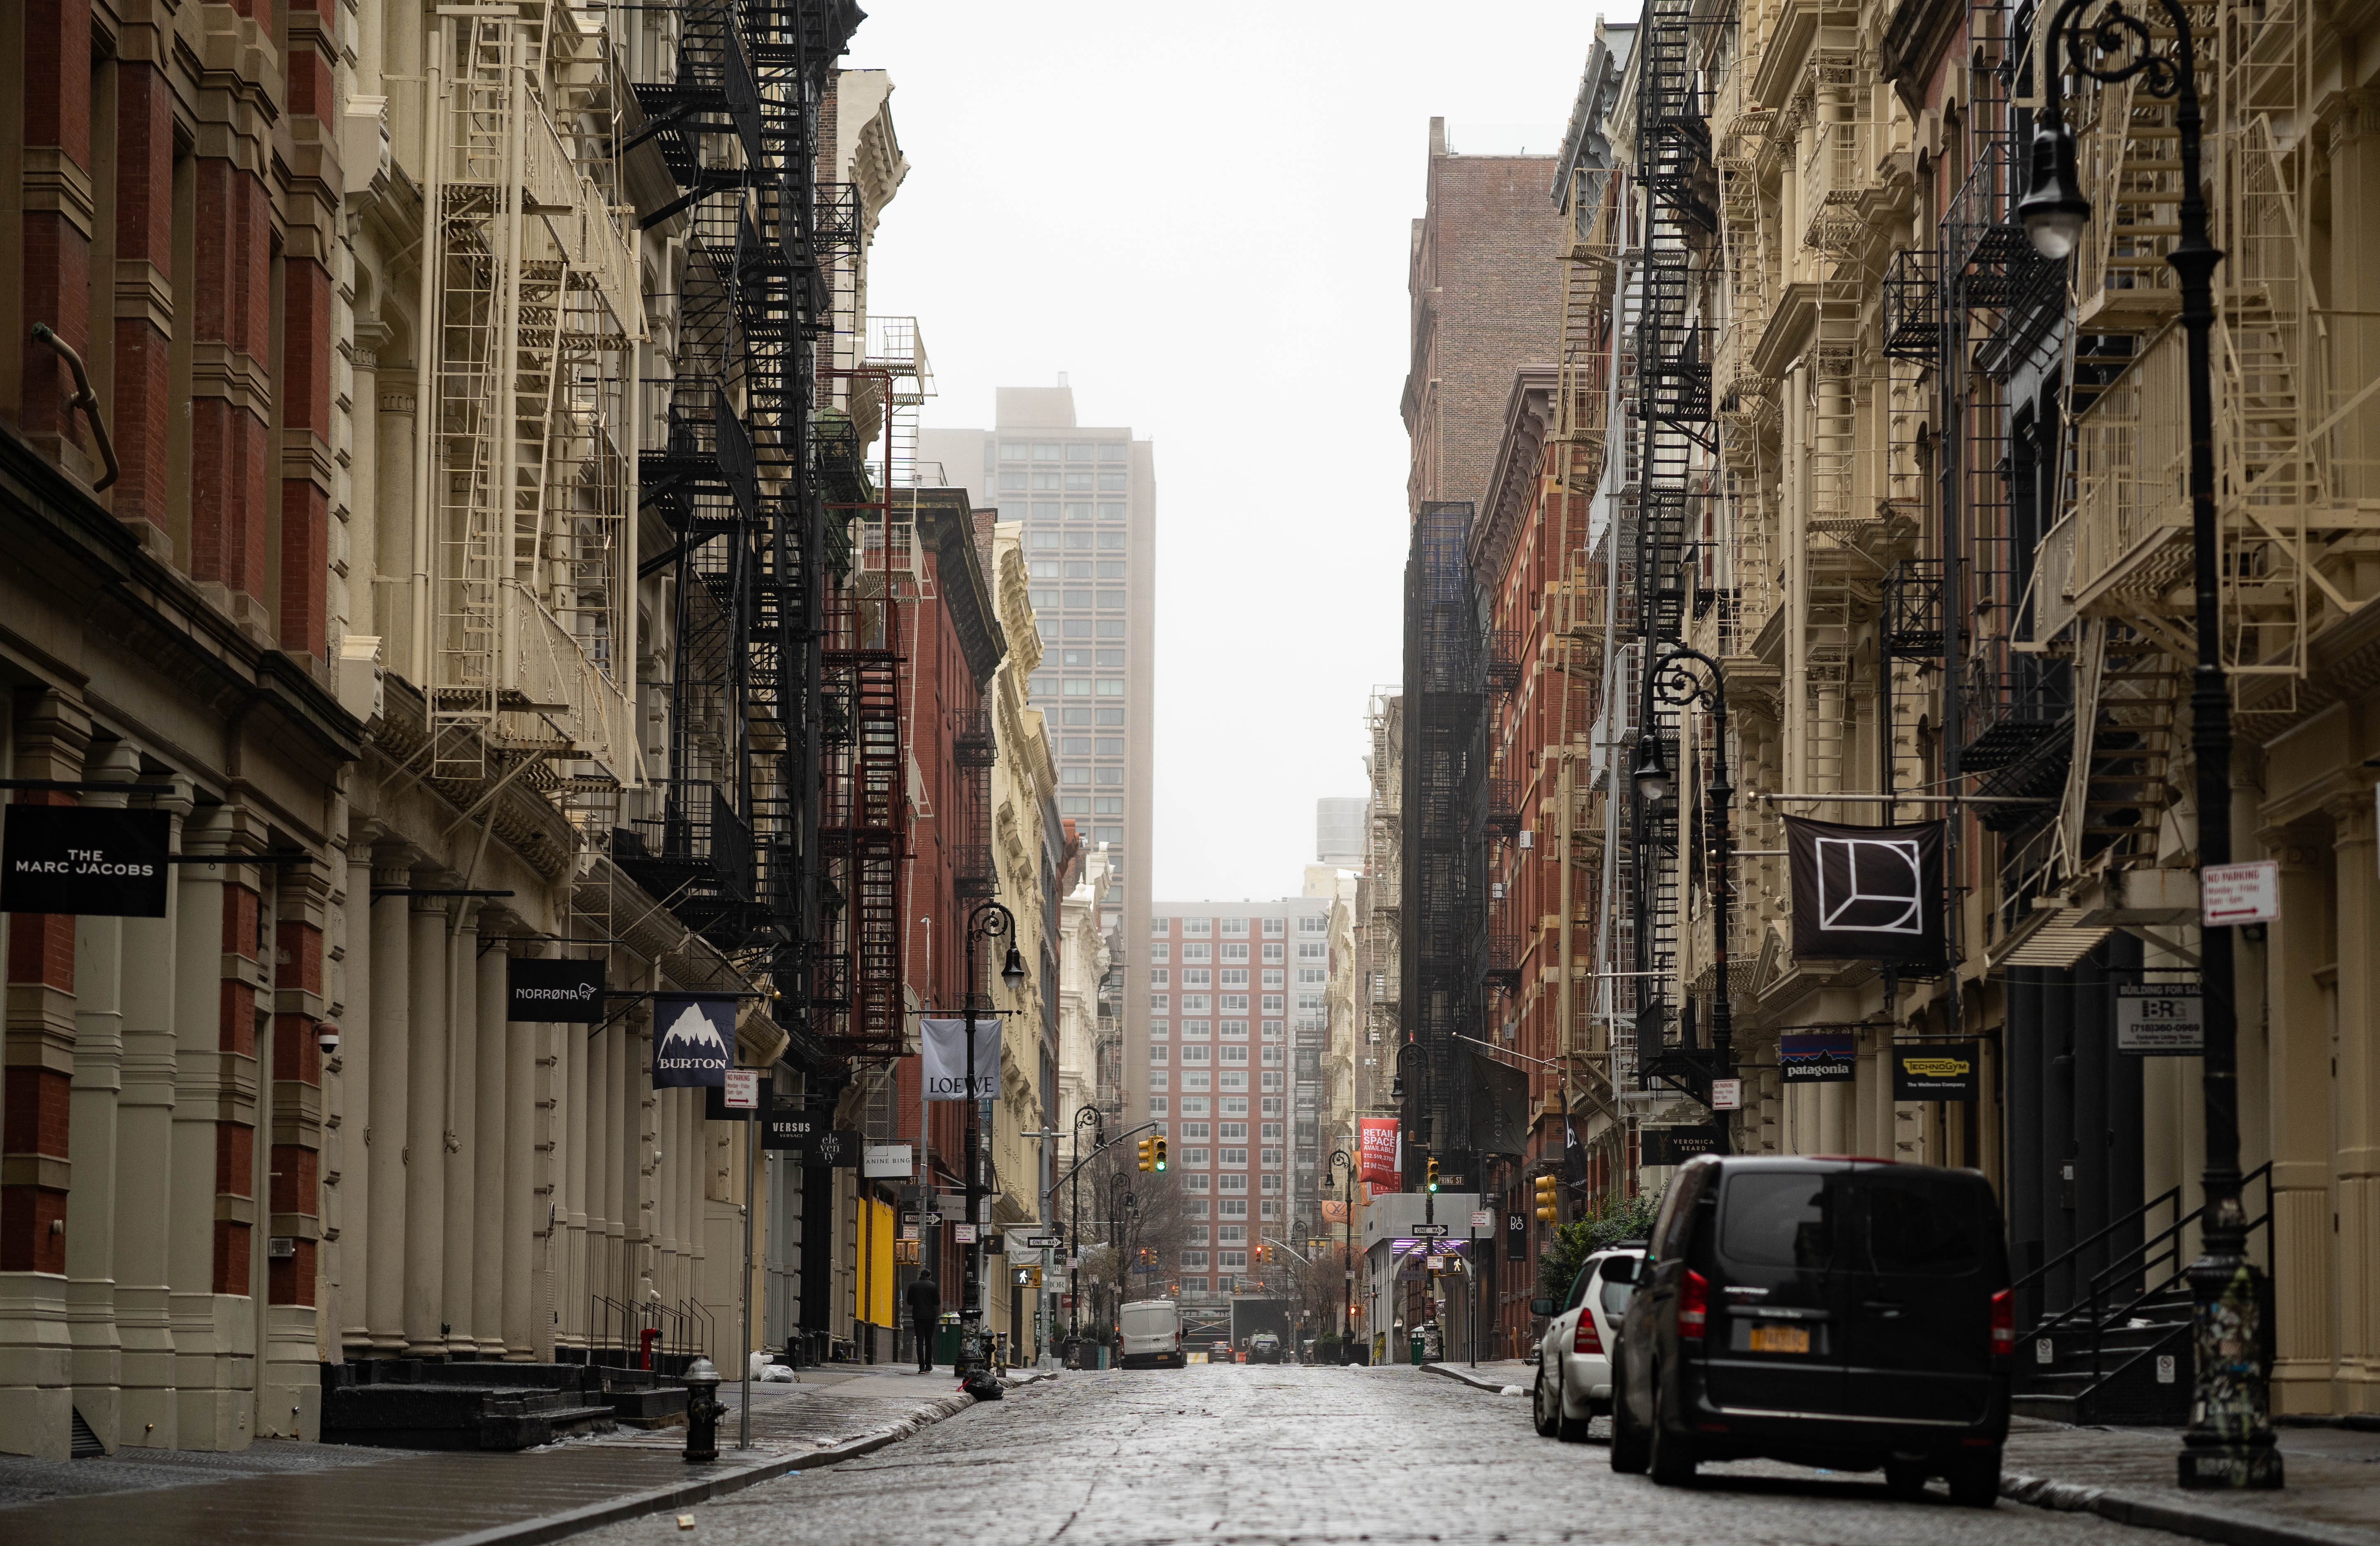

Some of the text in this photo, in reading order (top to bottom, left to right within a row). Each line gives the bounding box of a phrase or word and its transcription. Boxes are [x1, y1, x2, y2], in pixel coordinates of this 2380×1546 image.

[68, 849, 103, 861] THE
[16, 861, 153, 876] MARC JACOBS
[2208, 870, 2259, 883] NO PARKING
[516, 988, 578, 1000] NORRØNA
[2120, 985, 2202, 994] BUILDING FOR SAL
[660, 1058, 726, 1069] BURTON
[1787, 1064, 1849, 1077] patagonia
[929, 1077, 993, 1093] LOEWE
[773, 1122, 810, 1132] VERSUS
[822, 1133, 838, 1144] ele
[1363, 1129, 1395, 1138] RETAIL
[1363, 1136, 1395, 1148] SPACE
[1363, 1145, 1395, 1154] AVAILABLE
[825, 1152, 836, 1164] ty
